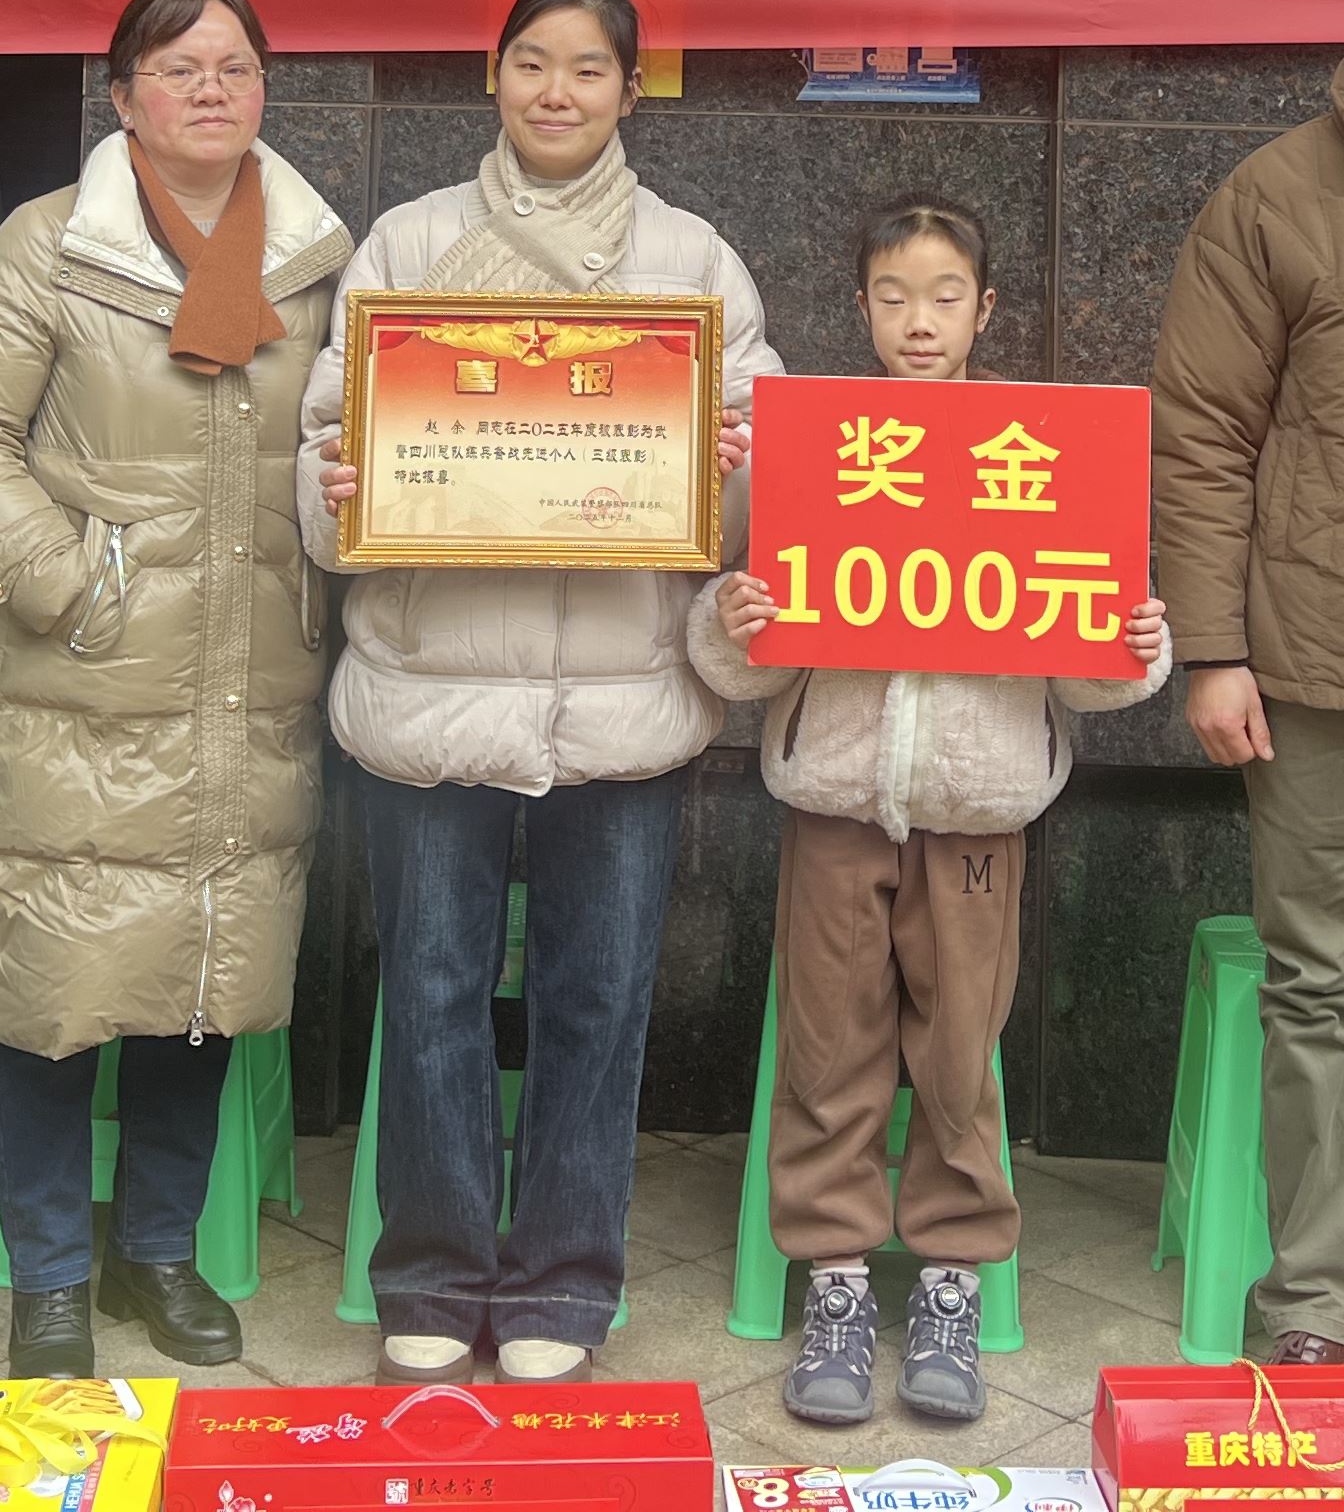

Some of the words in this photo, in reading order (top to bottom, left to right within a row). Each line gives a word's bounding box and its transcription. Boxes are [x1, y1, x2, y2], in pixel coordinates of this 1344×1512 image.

[837, 416, 1061, 512] 奖金
[774, 545, 1121, 641] 1000元
[962, 854, 994, 894] M
[511, 1410, 681, 1431] 江津米花糖
[1185, 1431, 1317, 1467] 重庆特产
